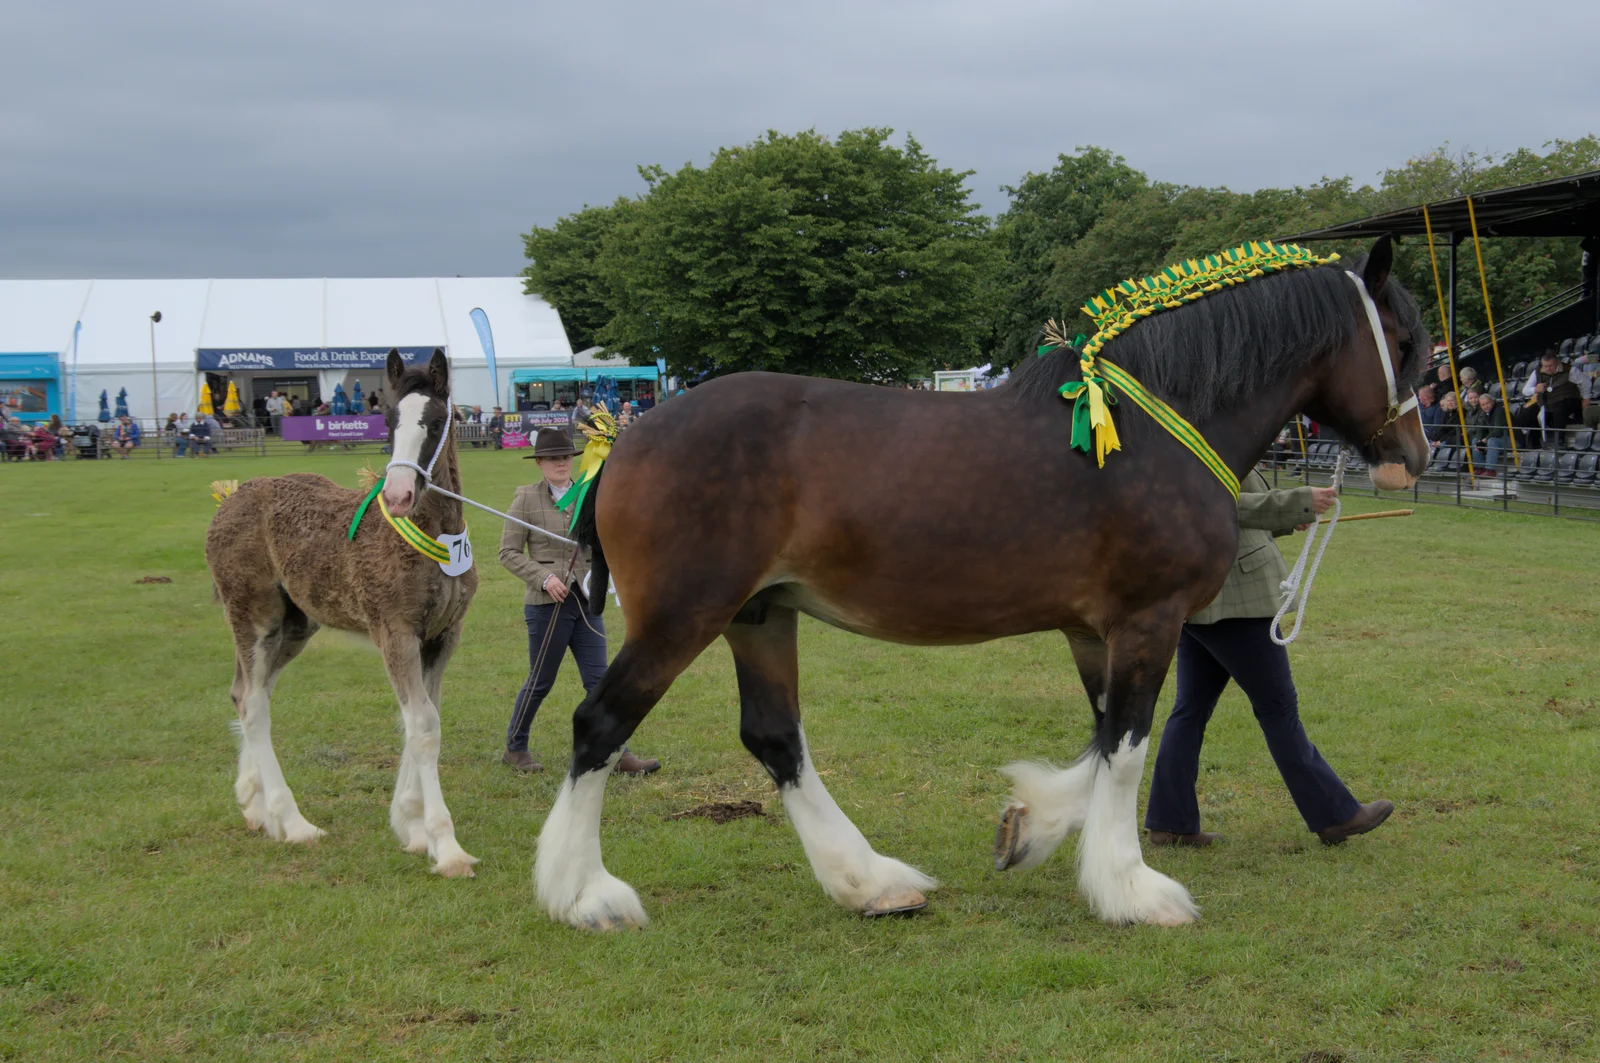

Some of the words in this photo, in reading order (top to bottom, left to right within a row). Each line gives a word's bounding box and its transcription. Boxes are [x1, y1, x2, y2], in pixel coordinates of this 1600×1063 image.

[217, 352, 275, 367] ADNAMS
[294, 351, 319, 361] Food
[320, 352, 329, 361] &
[331, 351, 358, 361] Drink
[328, 420, 369, 430] birketts
[452, 537, 470, 563] 76
